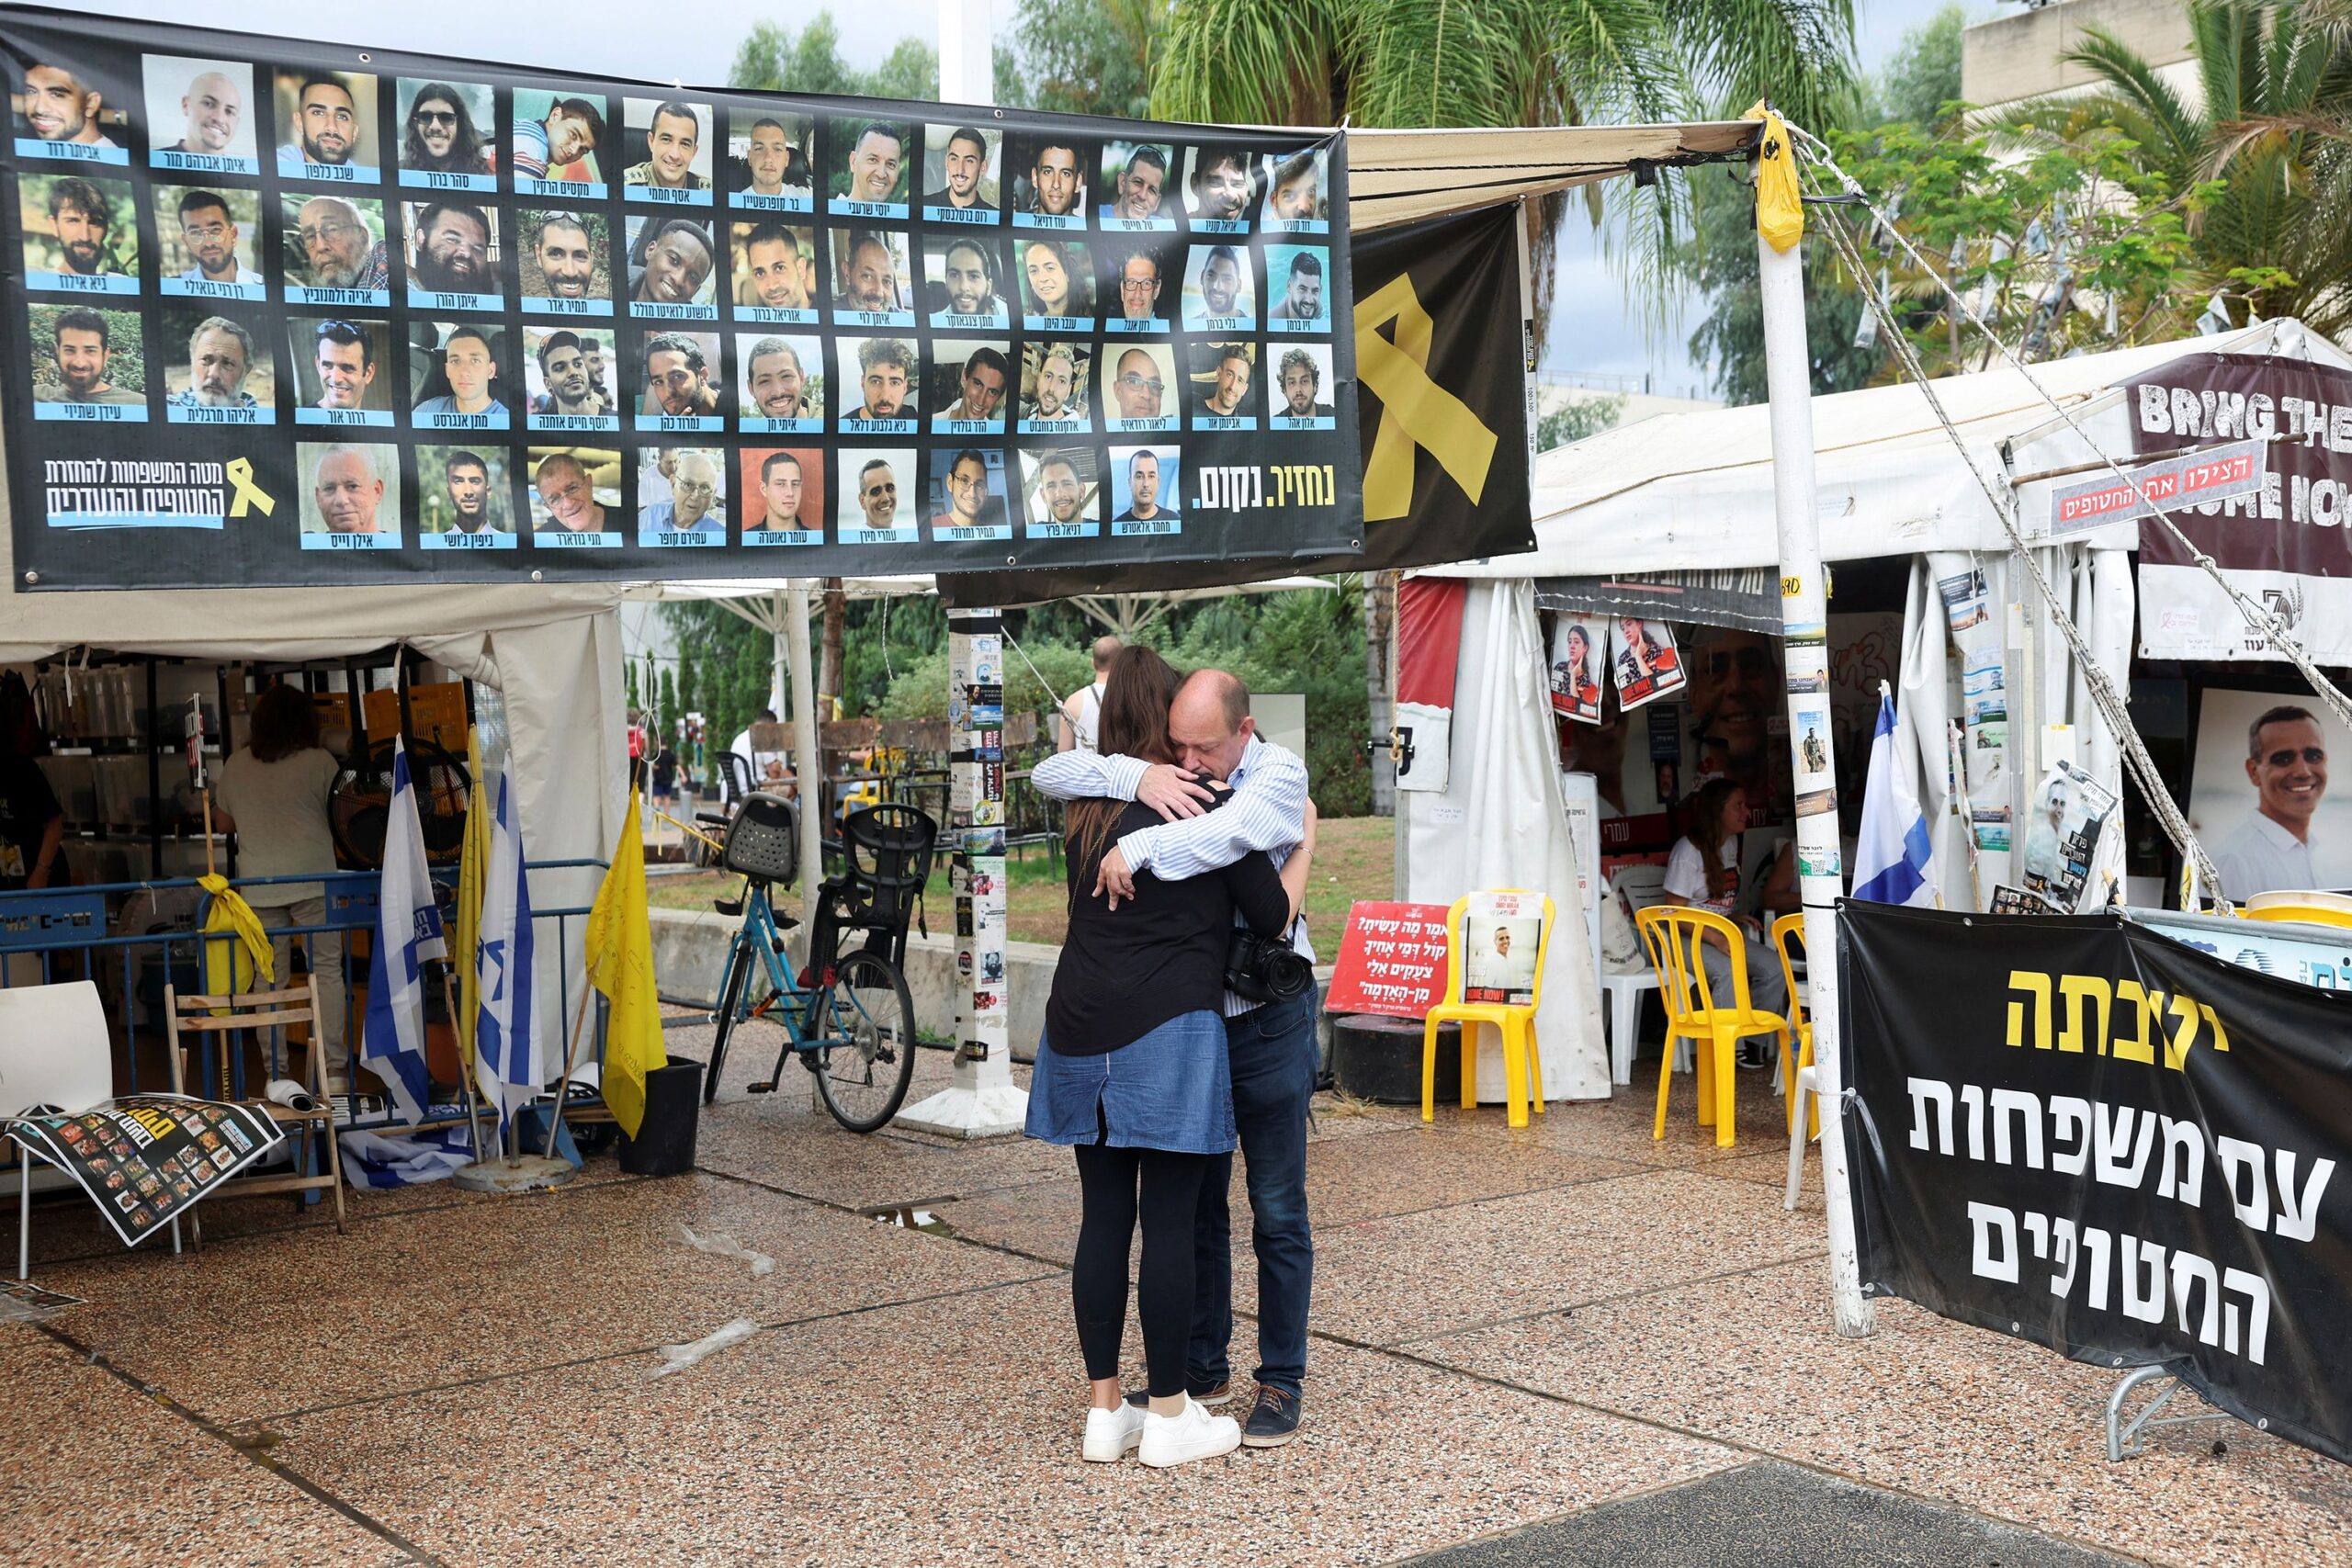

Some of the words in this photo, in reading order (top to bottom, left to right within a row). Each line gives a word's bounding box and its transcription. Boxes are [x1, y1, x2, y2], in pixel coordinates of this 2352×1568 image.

[2139, 384, 2275, 439] BRING
[46, 457, 107, 484] להחזרת
[111, 460, 187, 484] המשפחות
[190, 462, 223, 484] מטה
[1267, 464, 1336, 506] נחזיר.
[2189, 458, 2248, 487] הצילו
[47, 488, 138, 517] והנעדרים
[142, 488, 225, 517] החטופים
[1193, 466, 1261, 513] נקום.
[2065, 485, 2136, 517] החטופים
[2145, 477, 2174, 499] את
[2244, 639, 2265, 651] עוז
[1603, 822, 1630, 842] עמרי
[1907, 1077, 2205, 1208] משפחות
[2217, 1135, 2335, 1243] עם
[1967, 1201, 2270, 1366] החטופים
